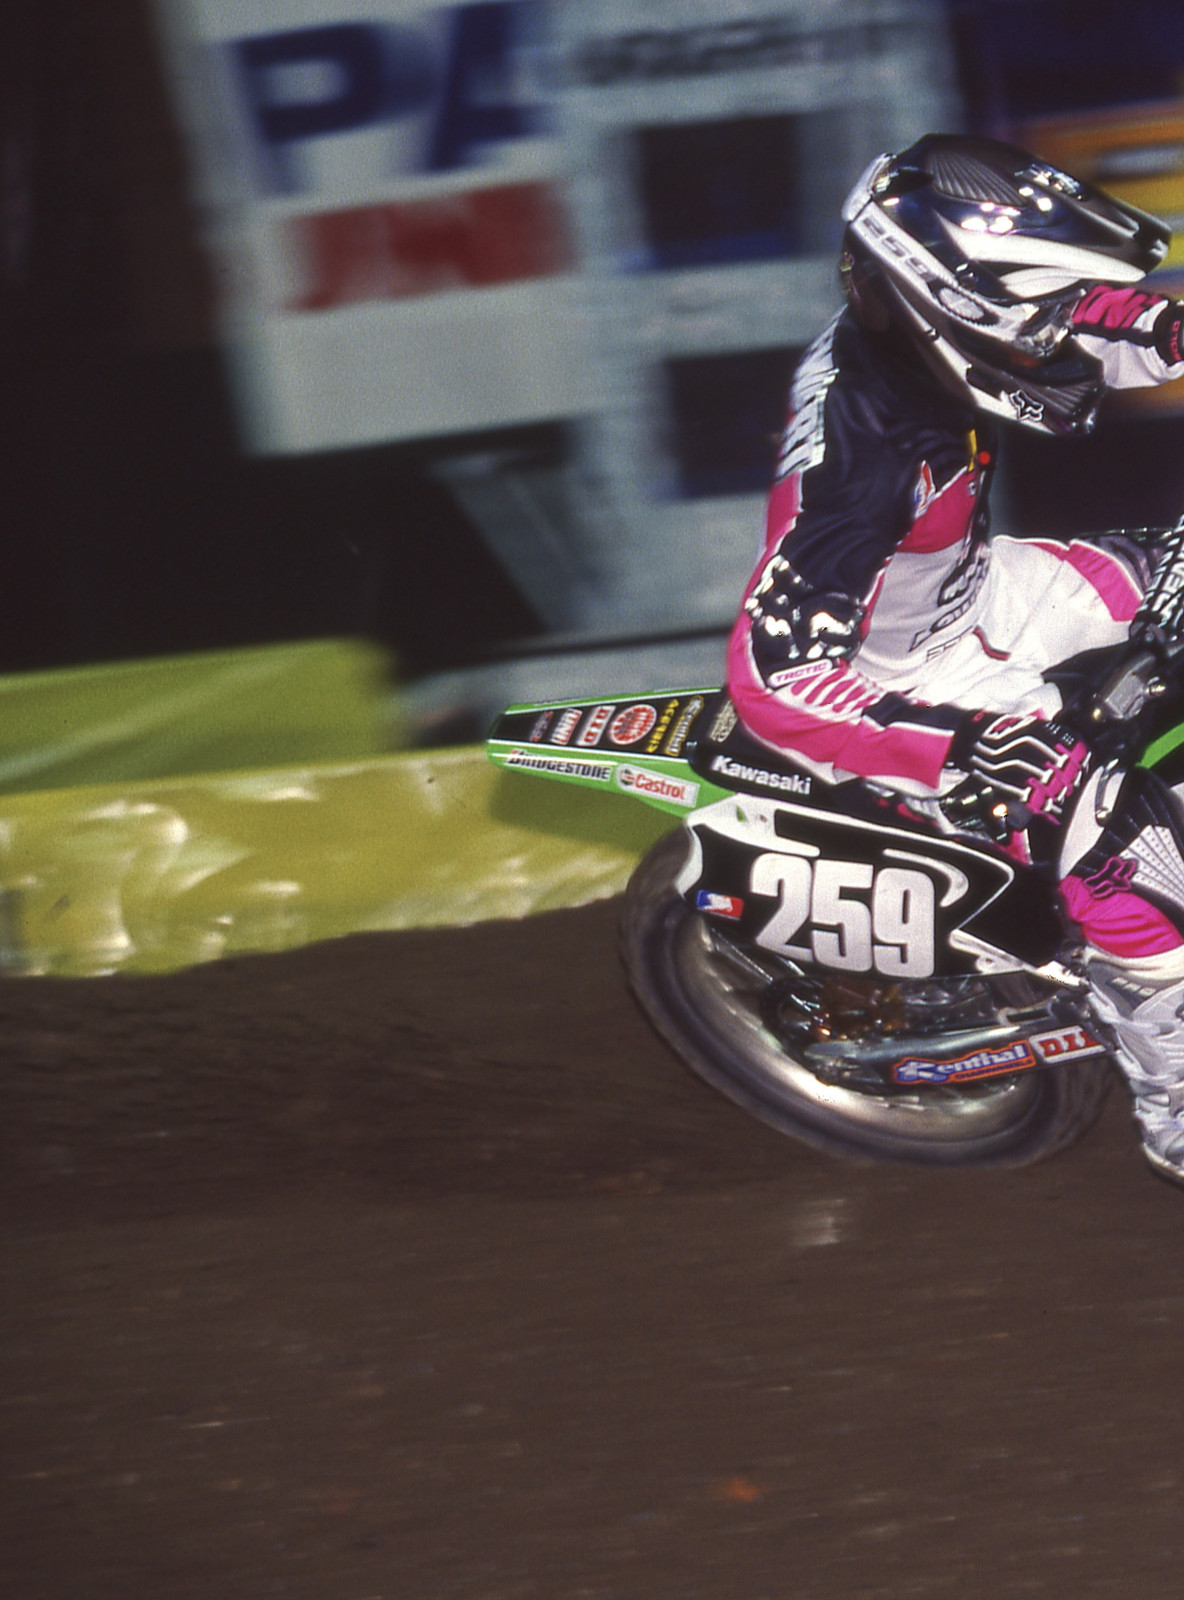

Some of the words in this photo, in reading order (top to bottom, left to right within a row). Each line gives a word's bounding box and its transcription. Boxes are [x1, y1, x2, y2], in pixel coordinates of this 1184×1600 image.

[505, 749, 611, 781] BRIDGESTONE
[711, 755, 811, 795] Kawasaki
[633, 772, 685, 801] Castrol
[750, 852, 935, 979] 259
[897, 1044, 1026, 1082] Renthal
